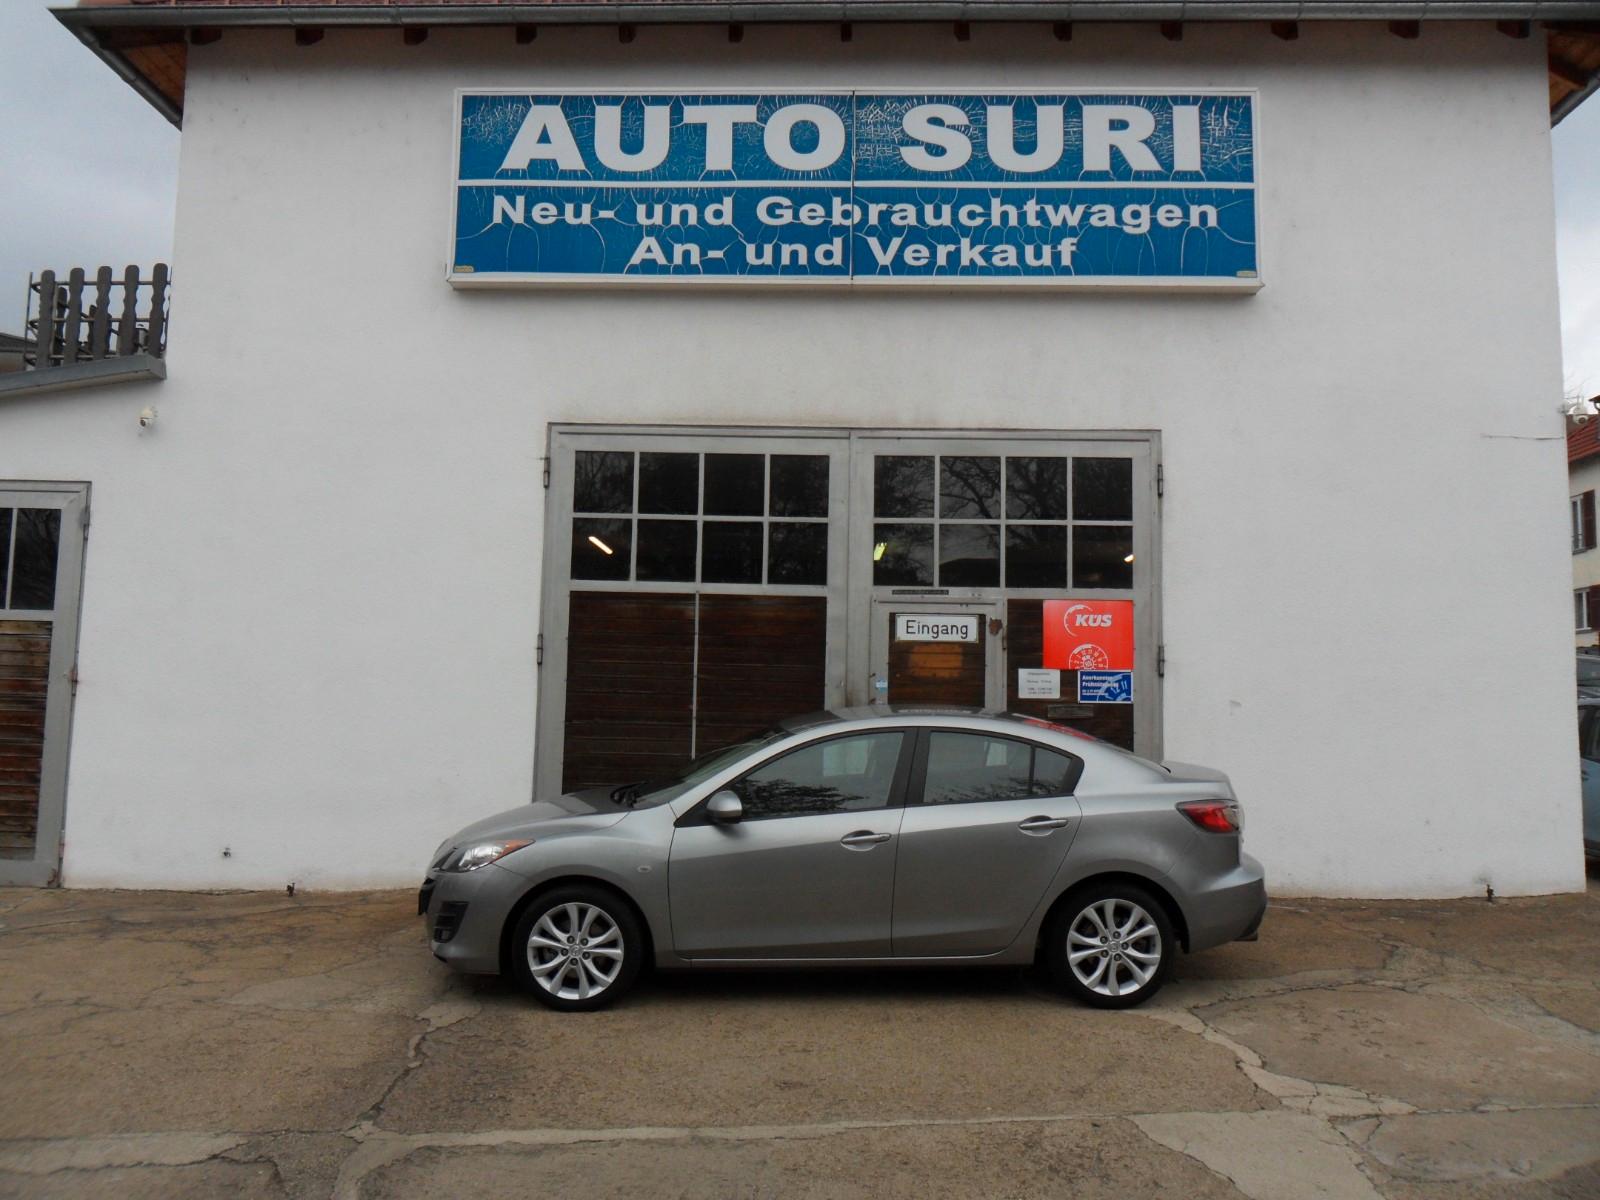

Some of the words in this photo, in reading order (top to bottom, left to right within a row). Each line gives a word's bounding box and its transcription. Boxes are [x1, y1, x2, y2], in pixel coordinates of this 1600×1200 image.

[500, 103, 846, 173] AUTO
[899, 103, 1202, 173] SURI
[493, 194, 617, 226] Neu-
[636, 196, 734, 226] und
[755, 195, 1218, 234] Gebrauchtwagen
[629, 236, 724, 266] An-
[745, 236, 843, 267] und
[866, 235, 1078, 269] Verkauf
[905, 619, 968, 640] Eingang
